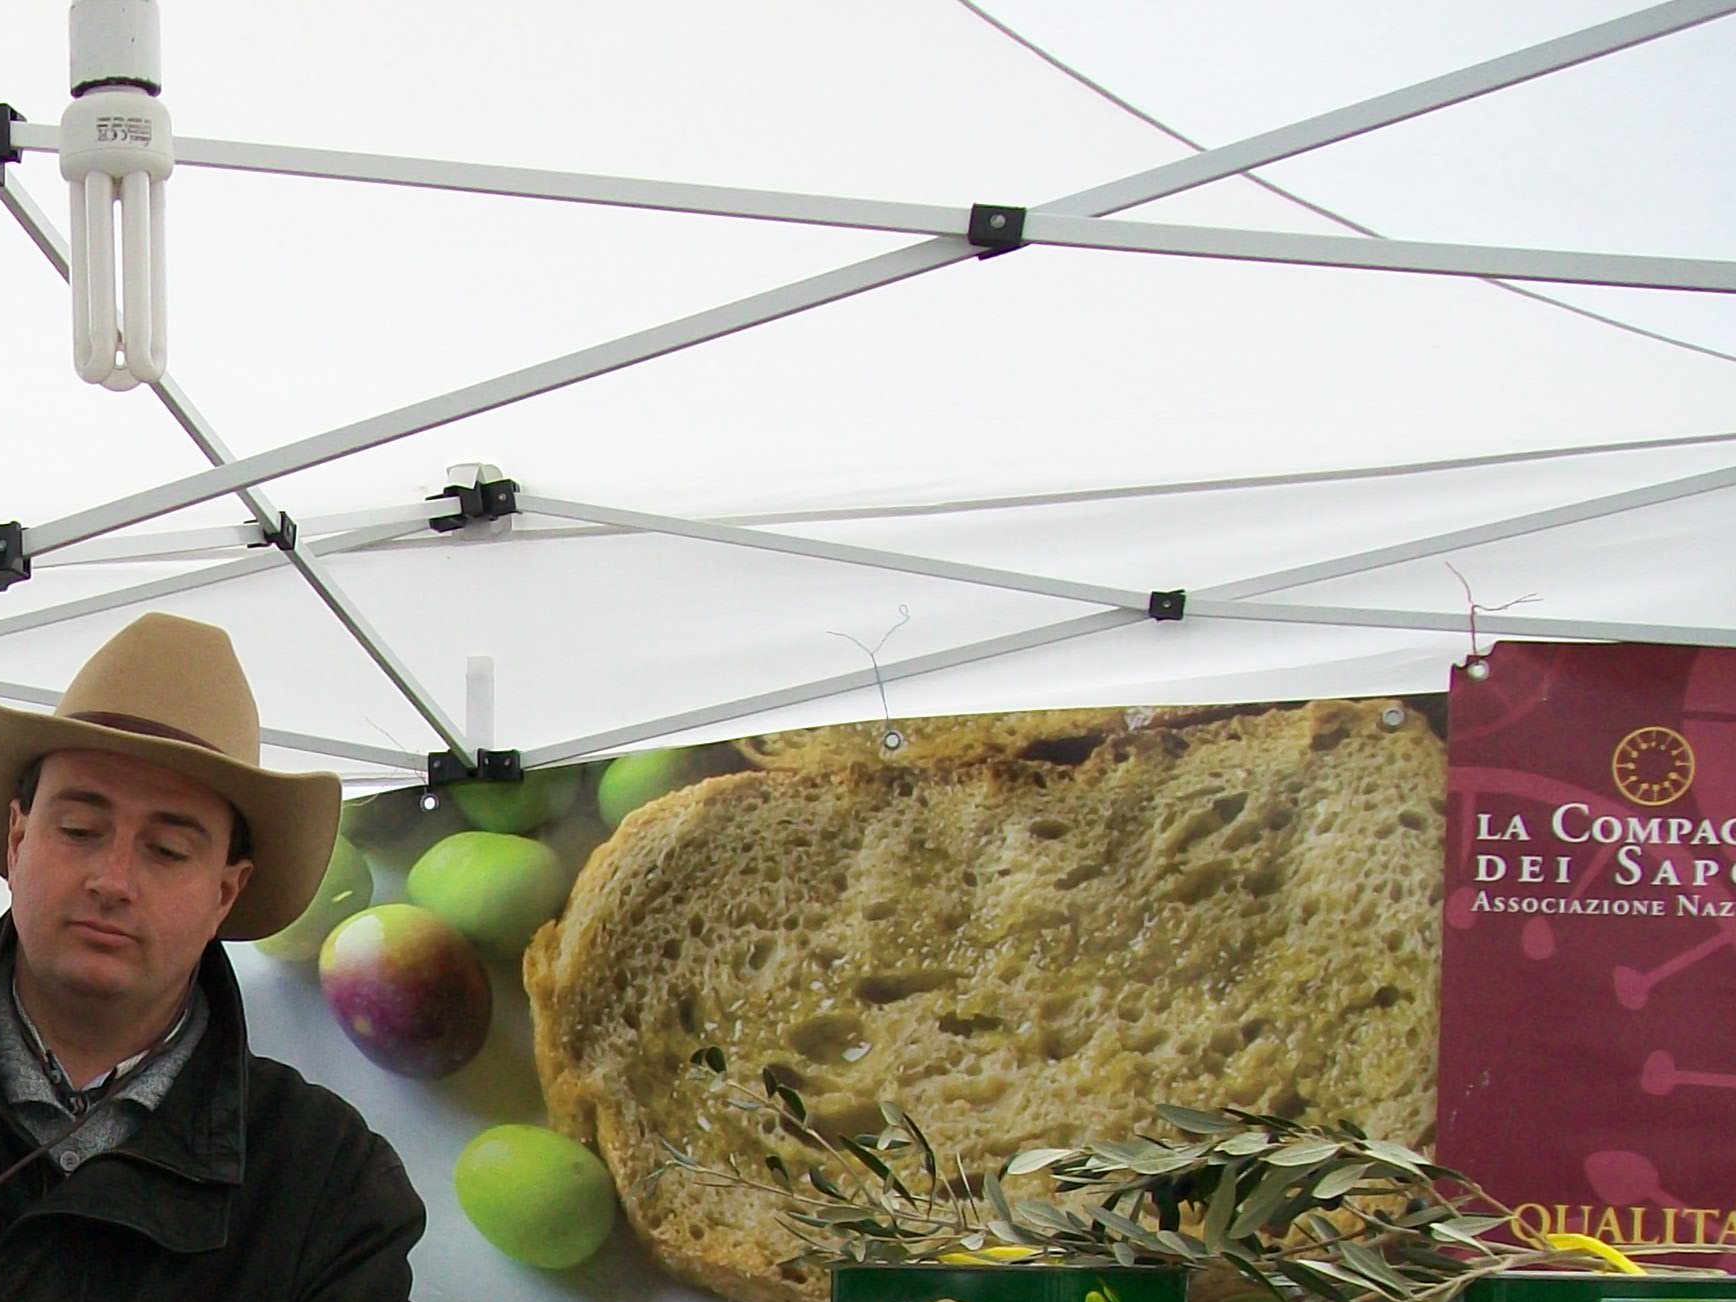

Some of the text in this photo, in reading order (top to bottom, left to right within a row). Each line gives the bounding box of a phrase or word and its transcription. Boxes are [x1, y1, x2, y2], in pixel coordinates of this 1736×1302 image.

[1476, 814, 1531, 841] LA
[1474, 845, 1736, 885] DEI SAP
[1471, 890, 1666, 915] ASSOCIAZIONE
